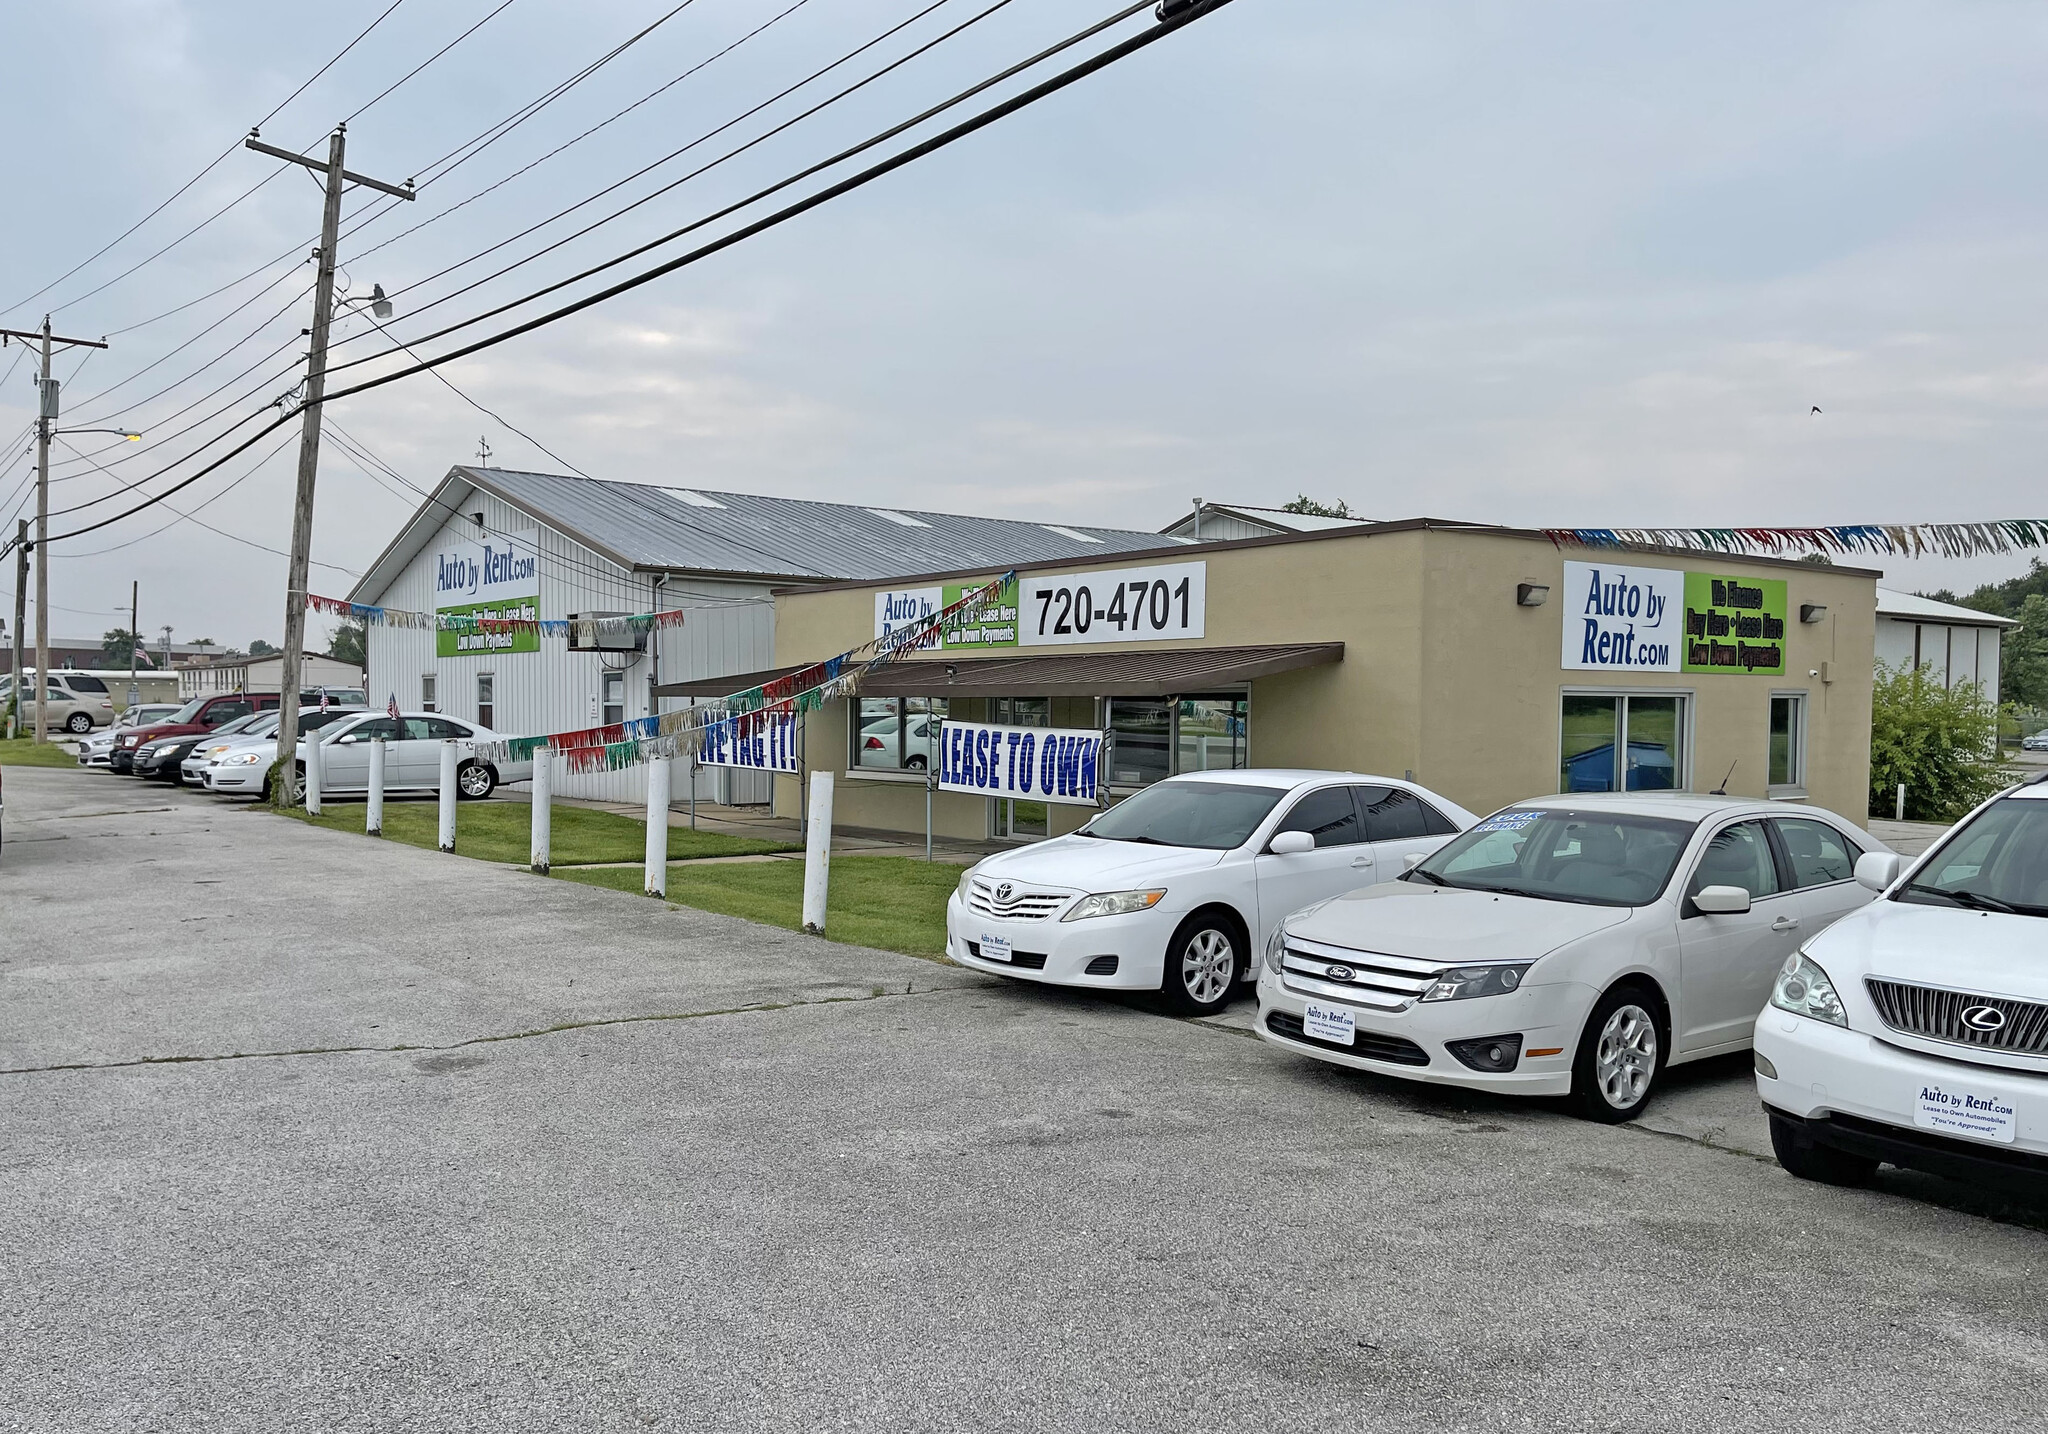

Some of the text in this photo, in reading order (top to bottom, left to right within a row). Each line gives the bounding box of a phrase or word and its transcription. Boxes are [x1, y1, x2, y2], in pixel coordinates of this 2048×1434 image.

[437, 553, 466, 592] Auto
[466, 557, 480, 596] by
[883, 592, 917, 621] Auto
[1035, 576, 1190, 636] 720-4701
[1584, 568, 1667, 628] Auto by
[1711, 579, 1763, 610] We Finance
[520, 602, 536, 621] Here
[1000, 603, 1017, 621] Here
[1707, 608, 1730, 637] Here
[1735, 610, 1762, 639] Lease
[1762, 612, 1784, 640] Here
[457, 630, 513, 652] Low Down Payments
[946, 625, 1015, 646] Low Down Payments
[1688, 637, 1781, 672] Low Down Payments
[729, 710, 766, 768] TAG
[940, 727, 1101, 800] LEASE TO OWN
[1329, 965, 1348, 978] Ford
[1306, 1006, 1321, 1018] Auto
[1321, 1013, 1328, 1022] by
[1919, 1086, 1948, 1104] Auto
[1950, 1095, 1962, 1109] by
[1923, 1104, 1941, 1113] Lease
[1949, 1109, 1965, 1118] Own
[1965, 1112, 2007, 1125] Automobiles
